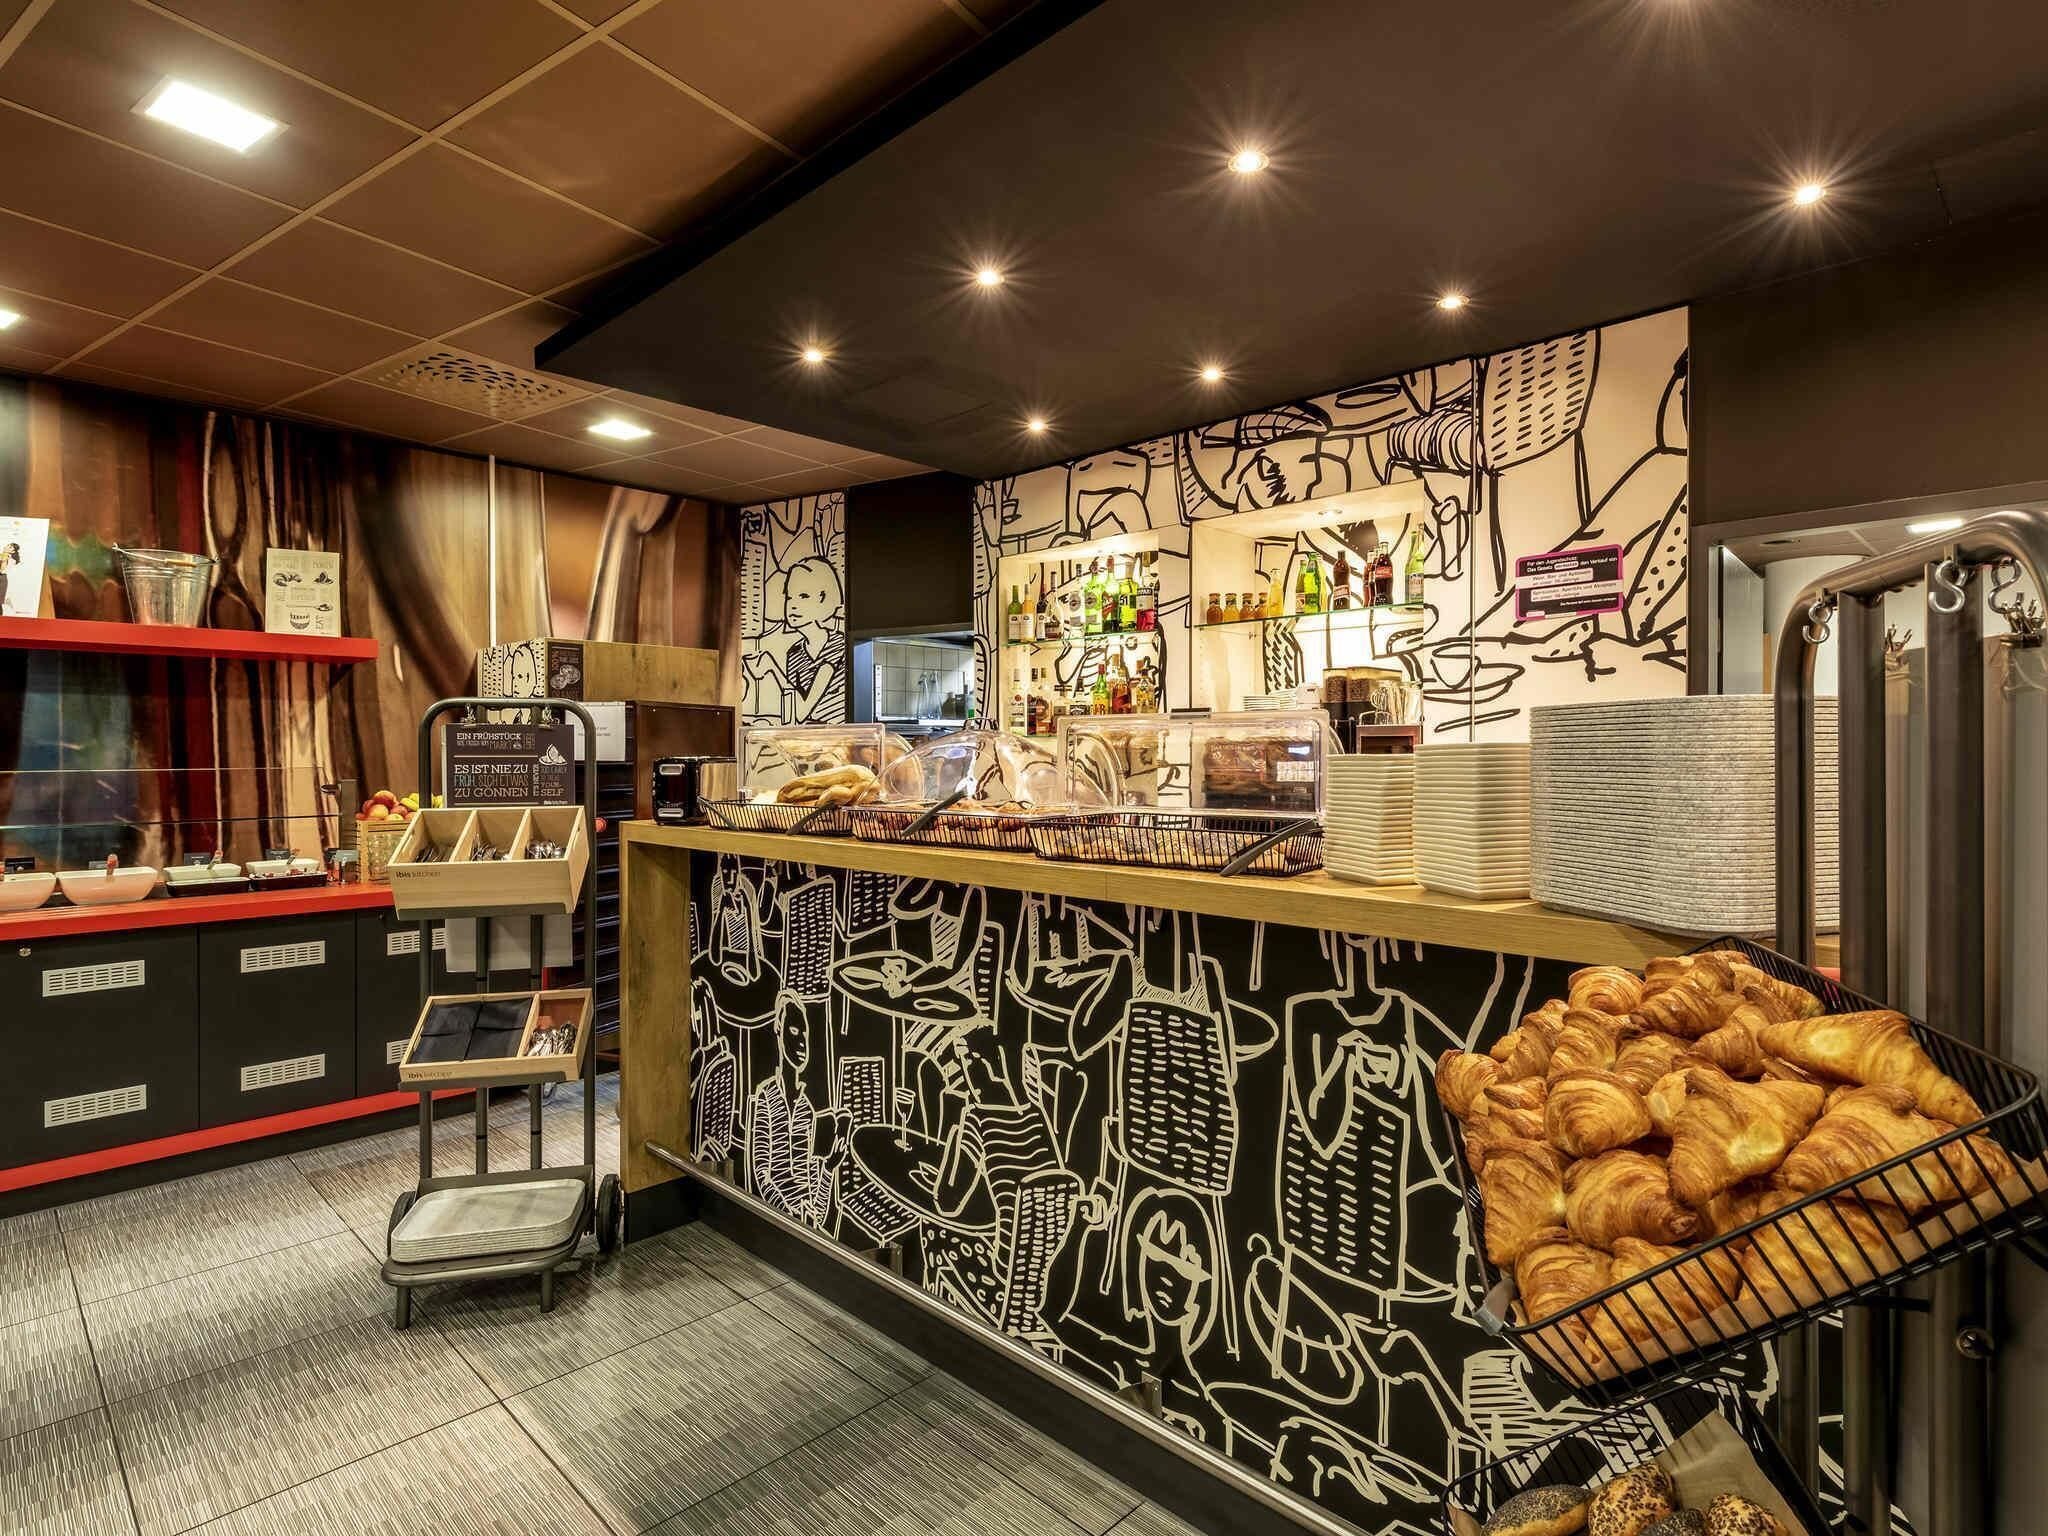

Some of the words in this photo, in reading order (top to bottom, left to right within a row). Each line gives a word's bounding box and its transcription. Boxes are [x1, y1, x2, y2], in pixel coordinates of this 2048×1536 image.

[456, 732, 471, 740] EIN
[472, 731, 522, 740] FRÜHSTÜCK
[454, 764, 470, 774] ES
[471, 764, 490, 774] IST
[491, 764, 512, 774] NIE
[513, 764, 529, 774] ZU
[500, 774, 529, 787] ETWAS
[454, 787, 471, 798] ZU
[473, 785, 529, 798] GÖNNEN
[540, 788, 565, 797] SELF
